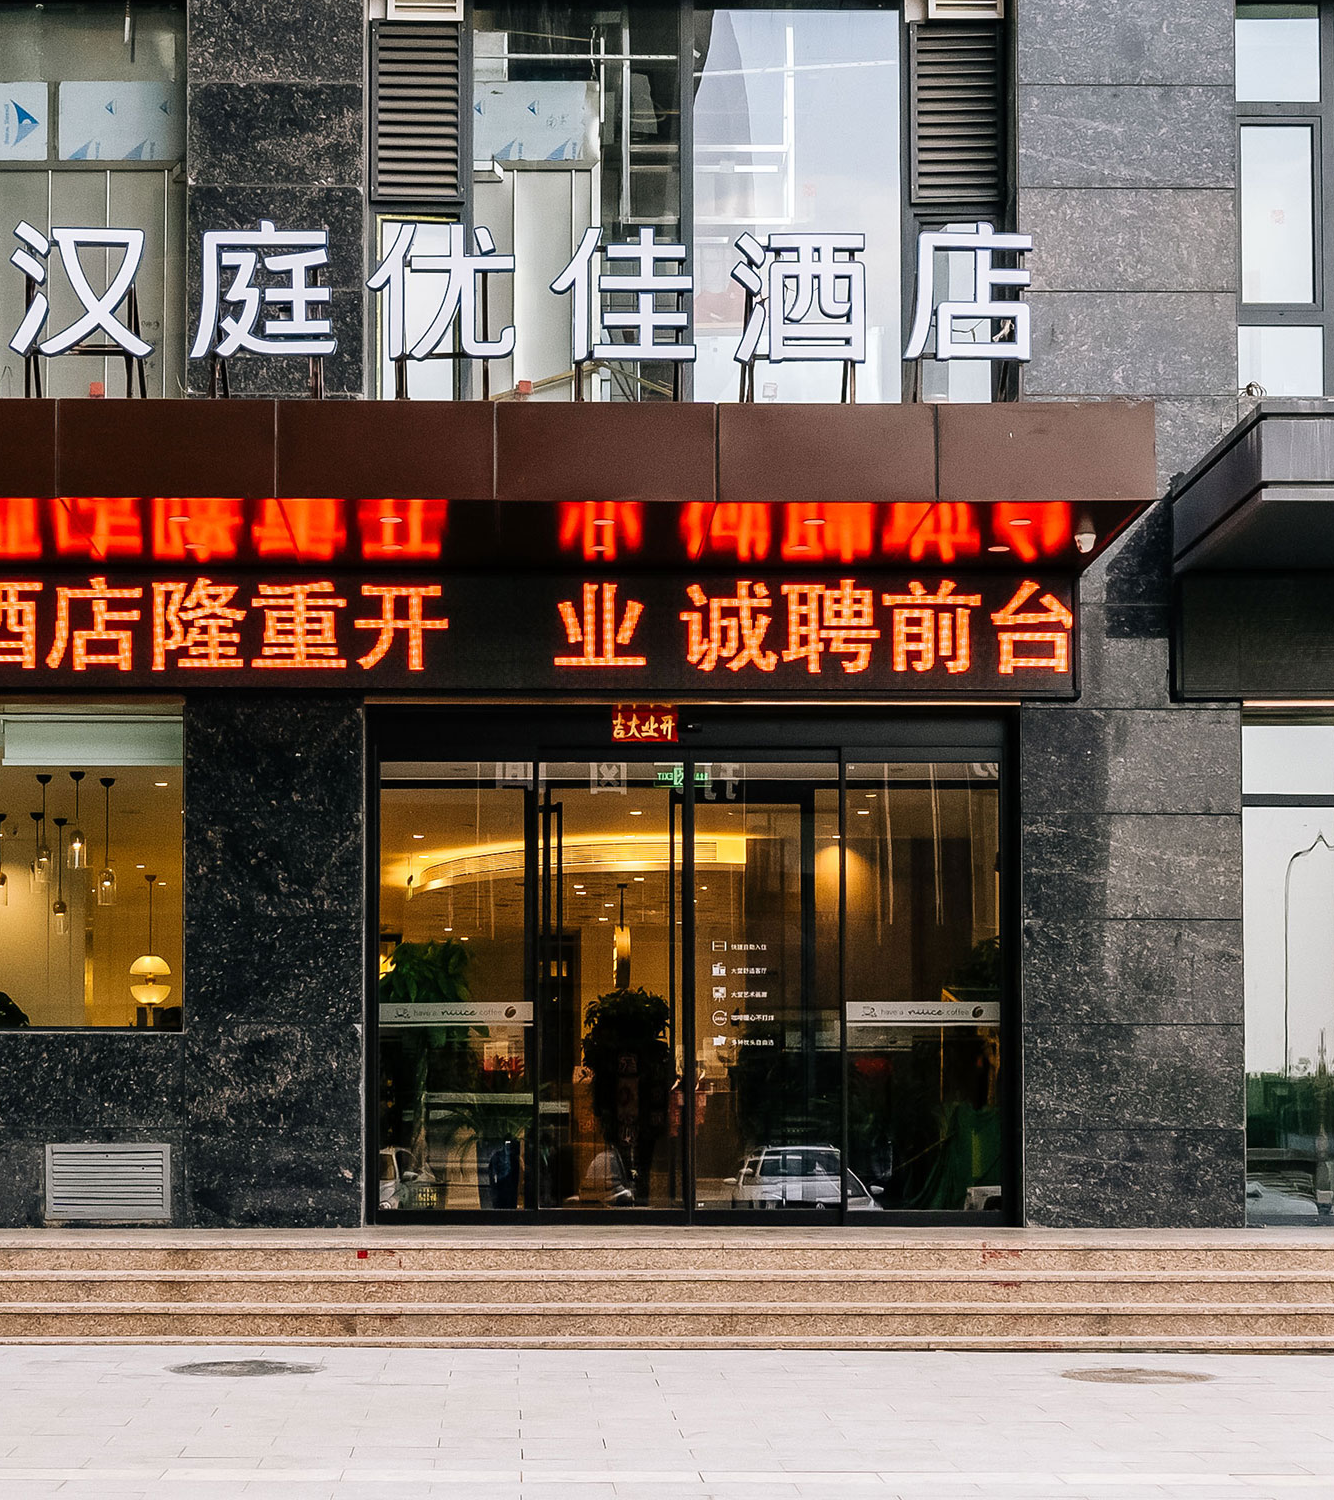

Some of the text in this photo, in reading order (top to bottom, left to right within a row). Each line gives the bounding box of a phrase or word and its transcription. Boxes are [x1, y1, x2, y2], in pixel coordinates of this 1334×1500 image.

[9, 221, 1032, 363] 汉庭优佳酒店
[880, 1008, 898, 1016] have
[946, 1008, 970, 1016] coffee
